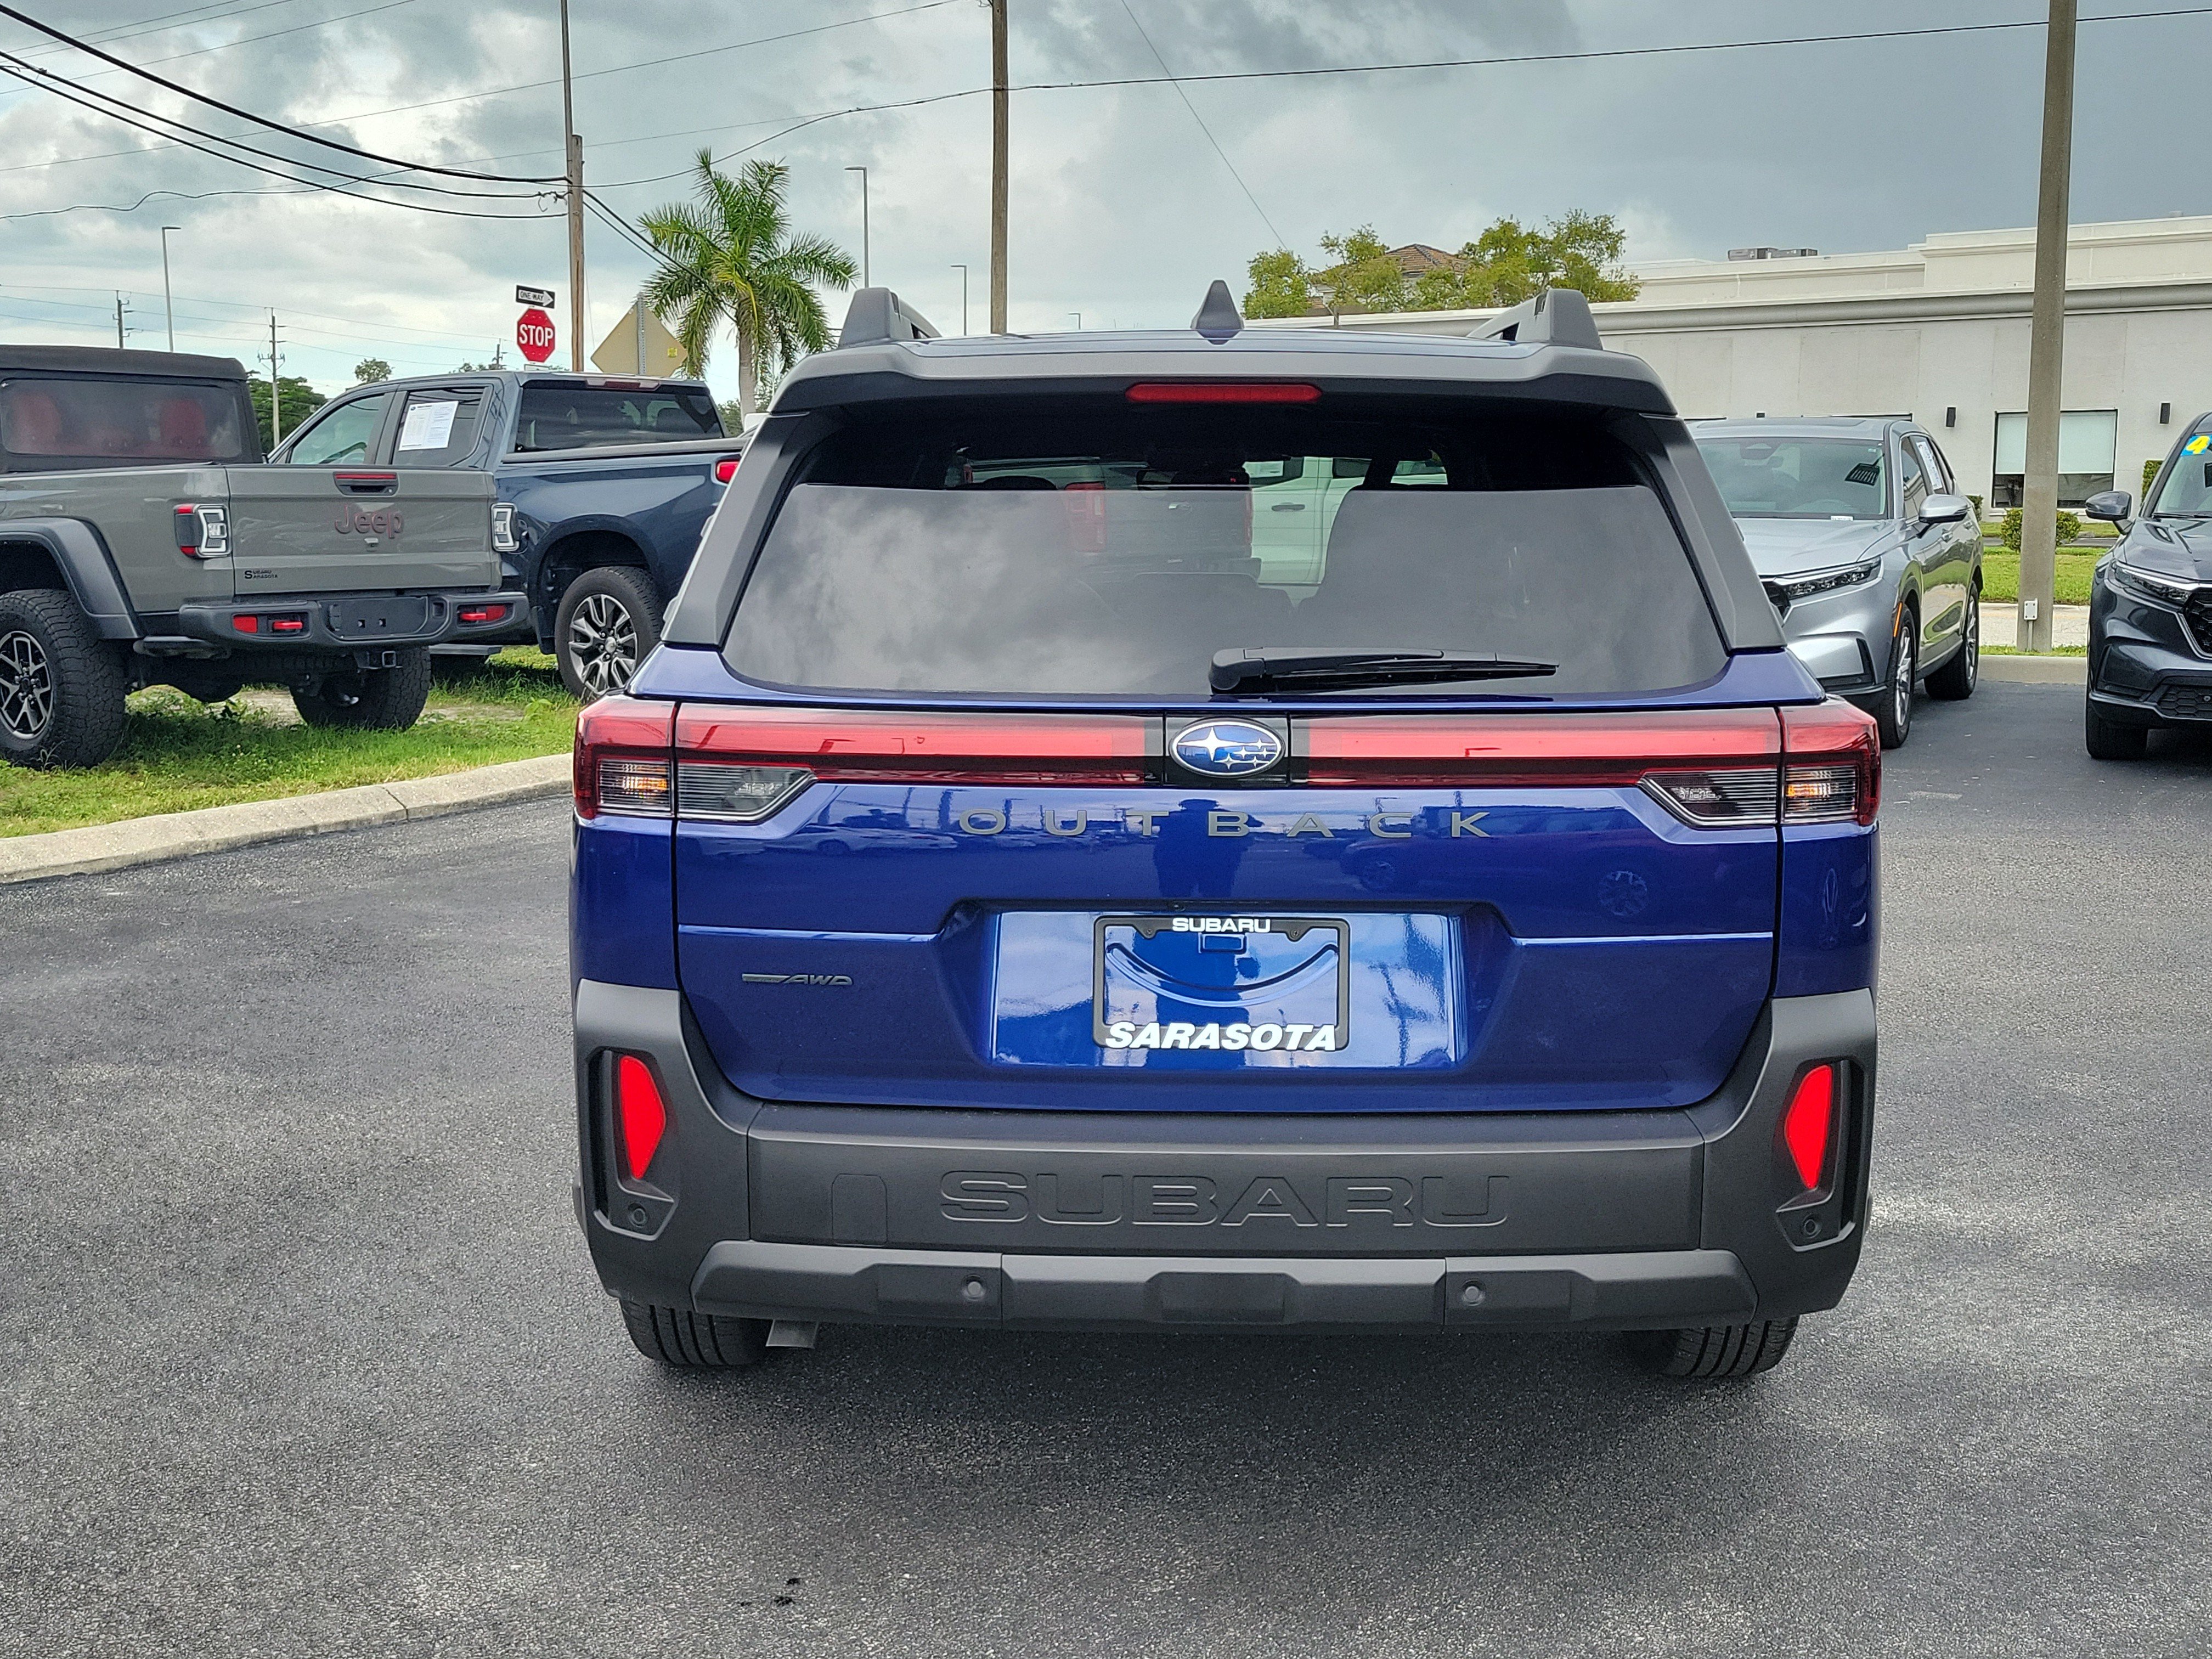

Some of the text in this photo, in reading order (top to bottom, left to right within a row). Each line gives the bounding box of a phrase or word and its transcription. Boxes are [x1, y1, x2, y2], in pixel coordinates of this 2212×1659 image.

[520, 291, 531, 300] ONE
[519, 324, 554, 347] STOP
[335, 504, 404, 539] Jeep
[959, 808, 1491, 838] OUTBACK
[1172, 917, 1271, 933] SUBARU
[783, 974, 853, 985] AWD
[1105, 1021, 1336, 1051] SARASOTA
[940, 1170, 1509, 1228] SUBARU
